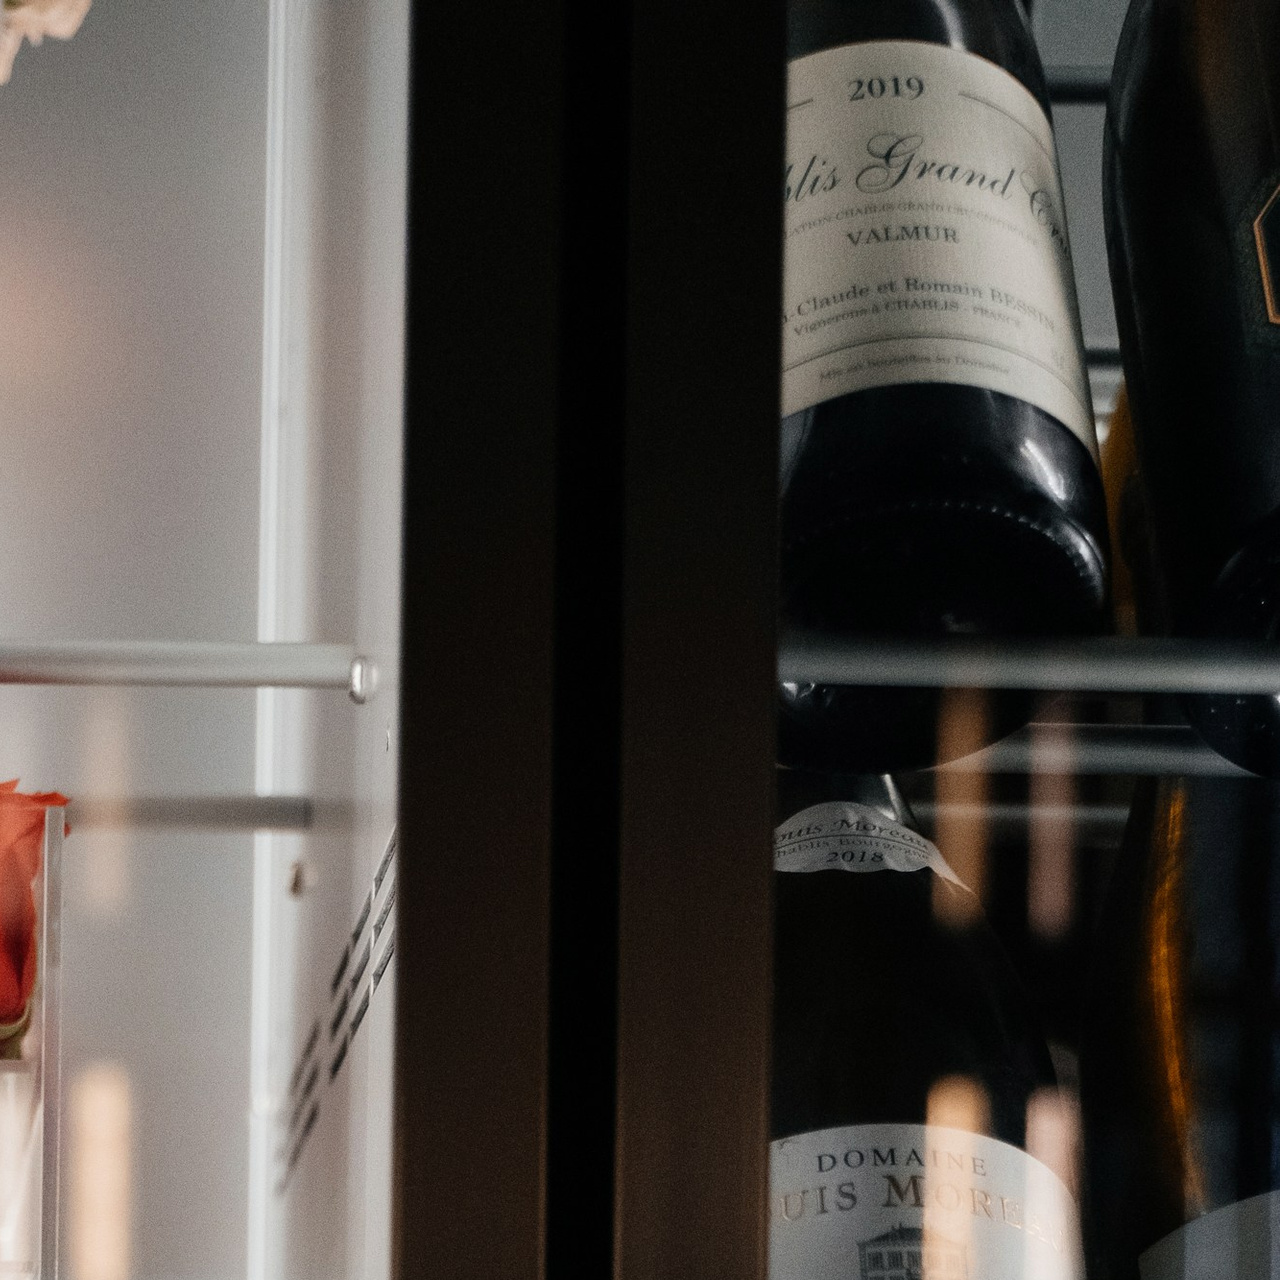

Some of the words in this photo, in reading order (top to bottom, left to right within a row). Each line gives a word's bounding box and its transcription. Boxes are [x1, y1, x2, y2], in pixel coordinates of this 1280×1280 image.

[848, 75, 925, 102] 2019
[855, 133, 1016, 201] Grand
[846, 225, 961, 248] VALMUR
[877, 282, 897, 295] et
[906, 277, 983, 299] Romain
[826, 850, 885, 863] 2018
[817, 1148, 987, 1177] DOMAINE
